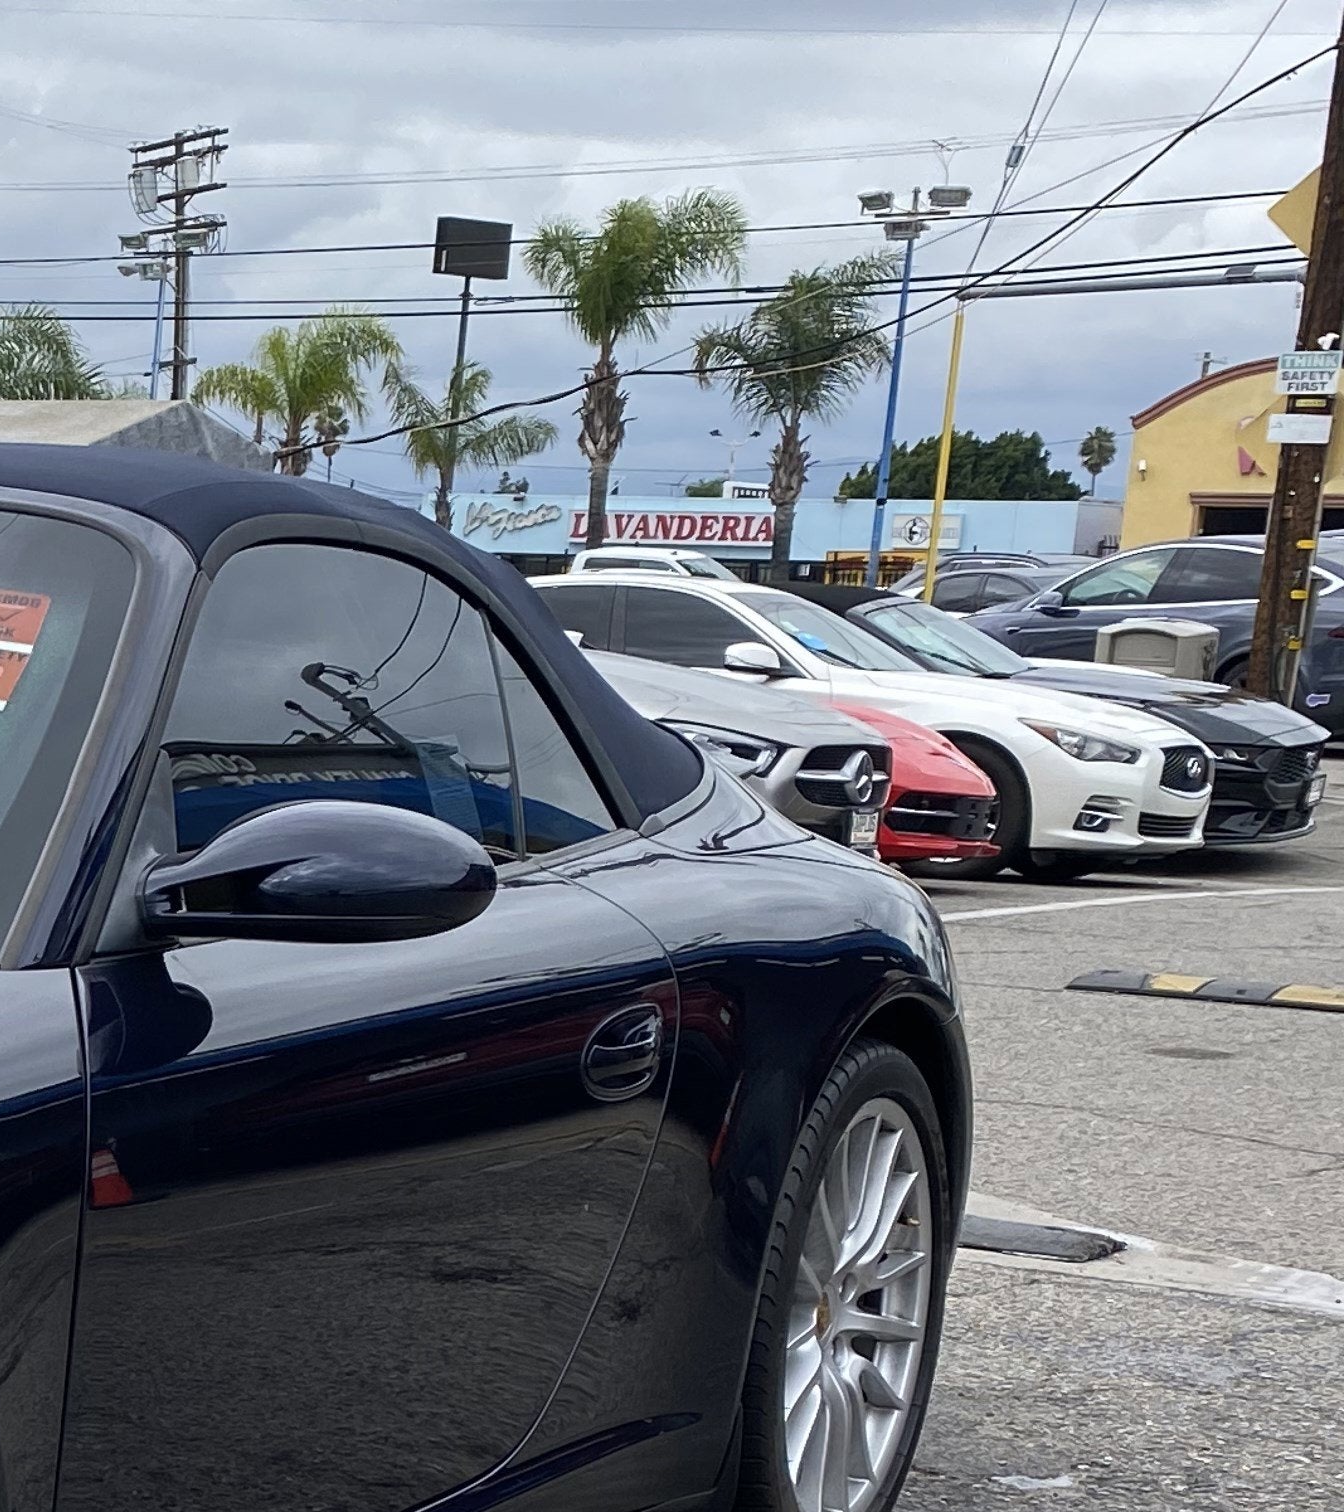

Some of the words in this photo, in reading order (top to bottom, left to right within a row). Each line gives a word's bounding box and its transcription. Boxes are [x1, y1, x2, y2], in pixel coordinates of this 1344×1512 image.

[1283, 355, 1338, 368] THINK
[1281, 370, 1335, 381] SAFETY
[1287, 382, 1328, 392] FIRST
[570, 513, 774, 542] LVANDERIA
